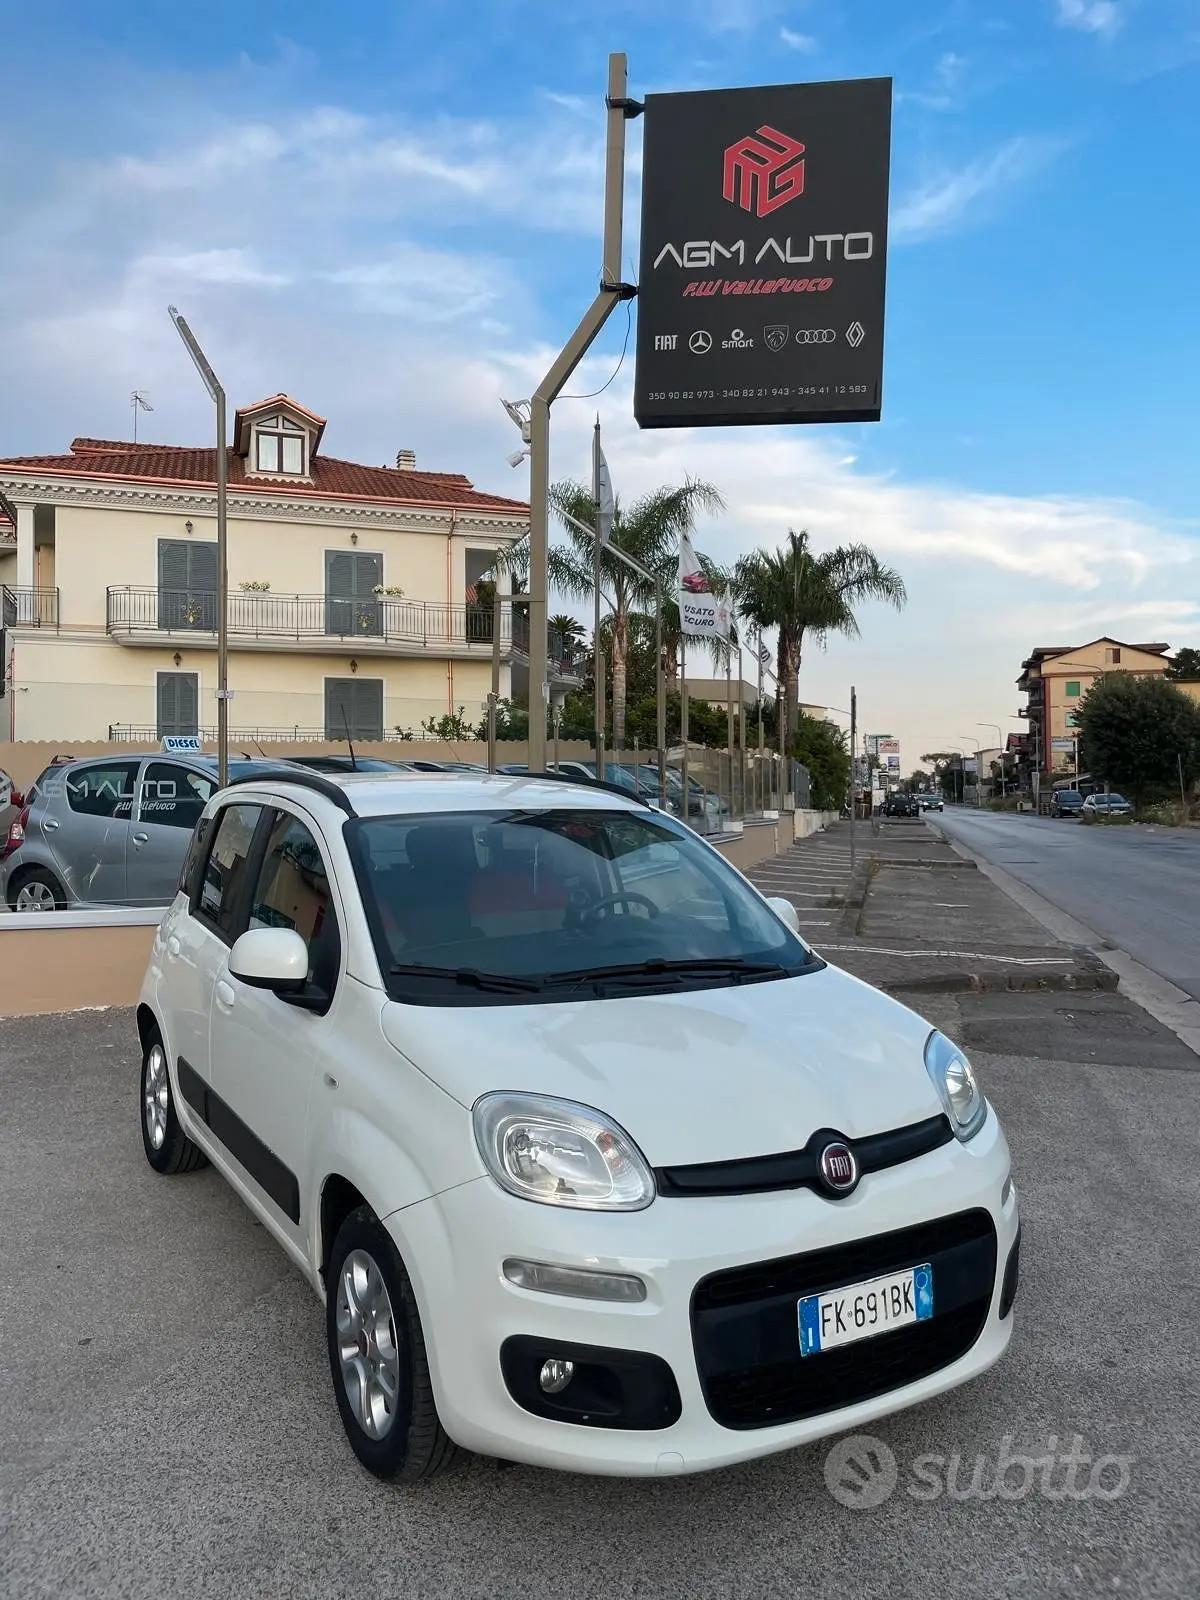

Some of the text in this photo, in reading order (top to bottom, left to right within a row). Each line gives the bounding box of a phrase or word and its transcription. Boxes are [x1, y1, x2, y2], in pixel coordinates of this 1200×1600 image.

[653, 231, 874, 269] AGM AUTO
[655, 334, 679, 351] FIAT
[721, 337, 754, 350] smart
[684, 604, 715, 616] USATO
[167, 738, 200, 748] DIESEL
[96, 780, 177, 798] AUTO
[829, 1155, 850, 1178] FIAT
